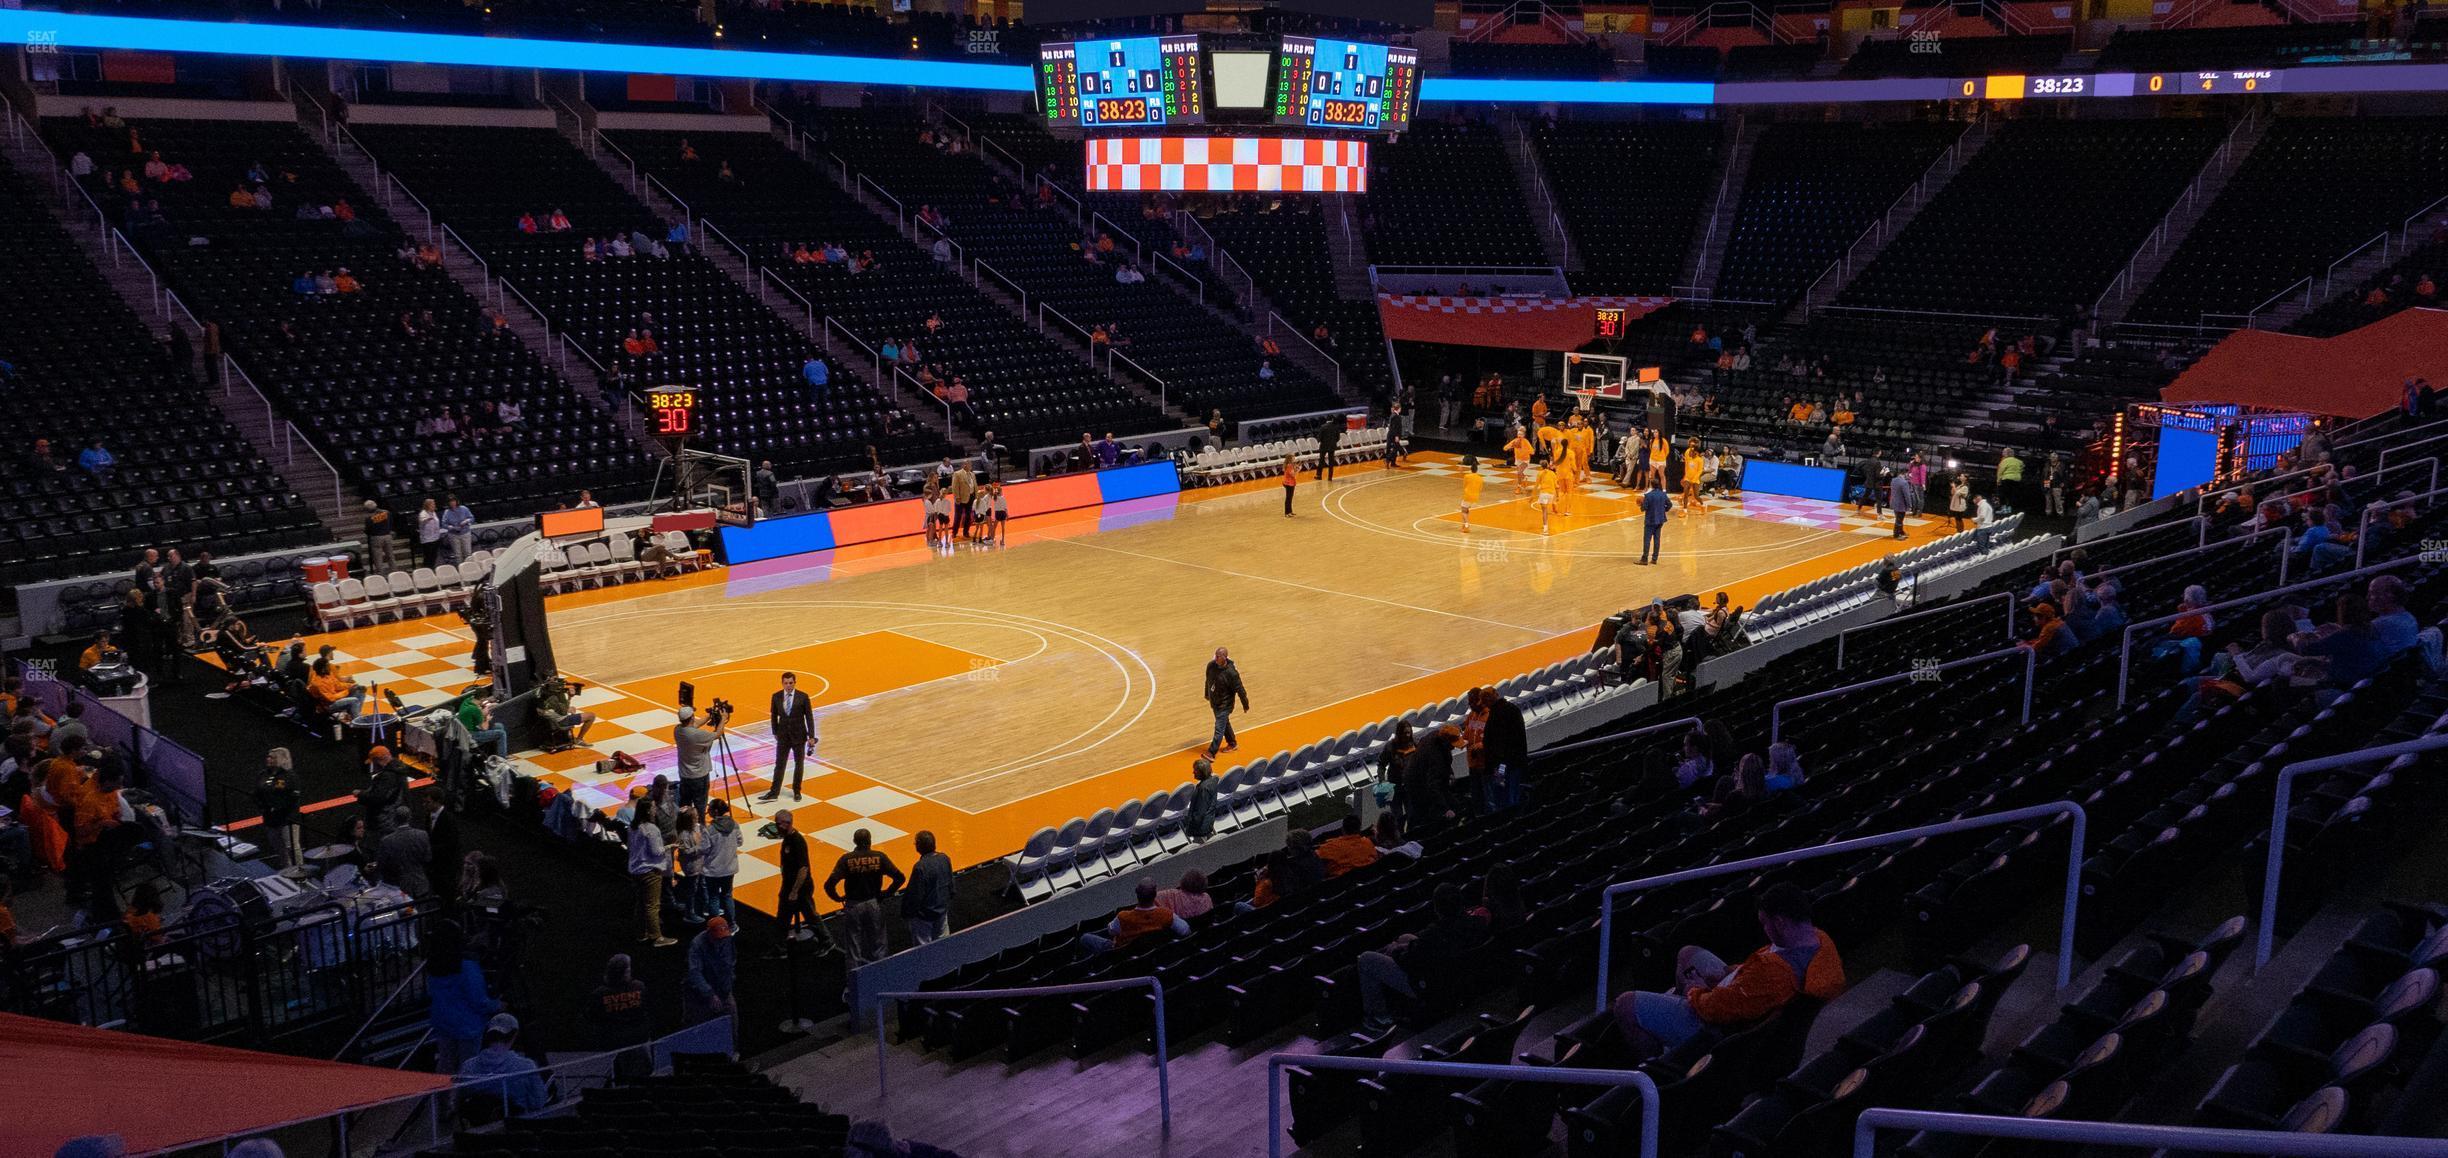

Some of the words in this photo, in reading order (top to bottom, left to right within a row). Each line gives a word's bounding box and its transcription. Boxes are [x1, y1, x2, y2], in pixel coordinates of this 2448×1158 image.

[1116, 53, 1120, 66] 1
[1349, 56, 1353, 68] 1
[1068, 74, 1076, 83] 17
[1165, 71, 1173, 79] 11
[1302, 71, 1311, 80] 17
[1087, 77, 1094, 90] 0
[1130, 81, 1135, 91] 4
[1146, 74, 1153, 88] 0
[1280, 82, 1288, 90] 13
[1319, 76, 1326, 90] 0
[1386, 79, 1392, 87] 11
[2034, 78, 2083, 93] 38:23
[2150, 76, 2162, 91] 0
[2202, 80, 2212, 90] 4
[2246, 79, 2256, 90] 0
[1047, 87, 1055, 95] 13
[1105, 82, 1110, 92] 4
[1165, 82, 1174, 91] 20
[1335, 84, 1340, 93] 4
[1356, 86, 1360, 95] 4
[1370, 80, 1376, 94] 0
[1963, 81, 1974, 95] 0
[1166, 95, 1175, 103] 21
[1278, 94, 1287, 103] 23
[1300, 95, 1308, 104] 10
[1384, 90, 1392, 98] 20
[1048, 98, 1056, 106] 23
[1070, 97, 1078, 106] 10
[1382, 102, 1389, 110] 21
[1048, 110, 1057, 118] 33
[1100, 100, 1145, 120] 38:23
[1152, 110, 1158, 120] 0
[1166, 106, 1176, 115] 24
[1277, 106, 1286, 114] 33
[1325, 102, 1365, 122] 38:23
[1087, 112, 1092, 121] 0
[1313, 111, 1318, 120] 0
[1369, 114, 1374, 124] 0
[1381, 112, 1389, 120] 24
[1597, 312, 1618, 321] 38:23
[1600, 321, 1614, 335] 30
[652, 393, 692, 408] 38:23
[659, 409, 686, 431] 30
[848, 856, 880, 866] EVENT
